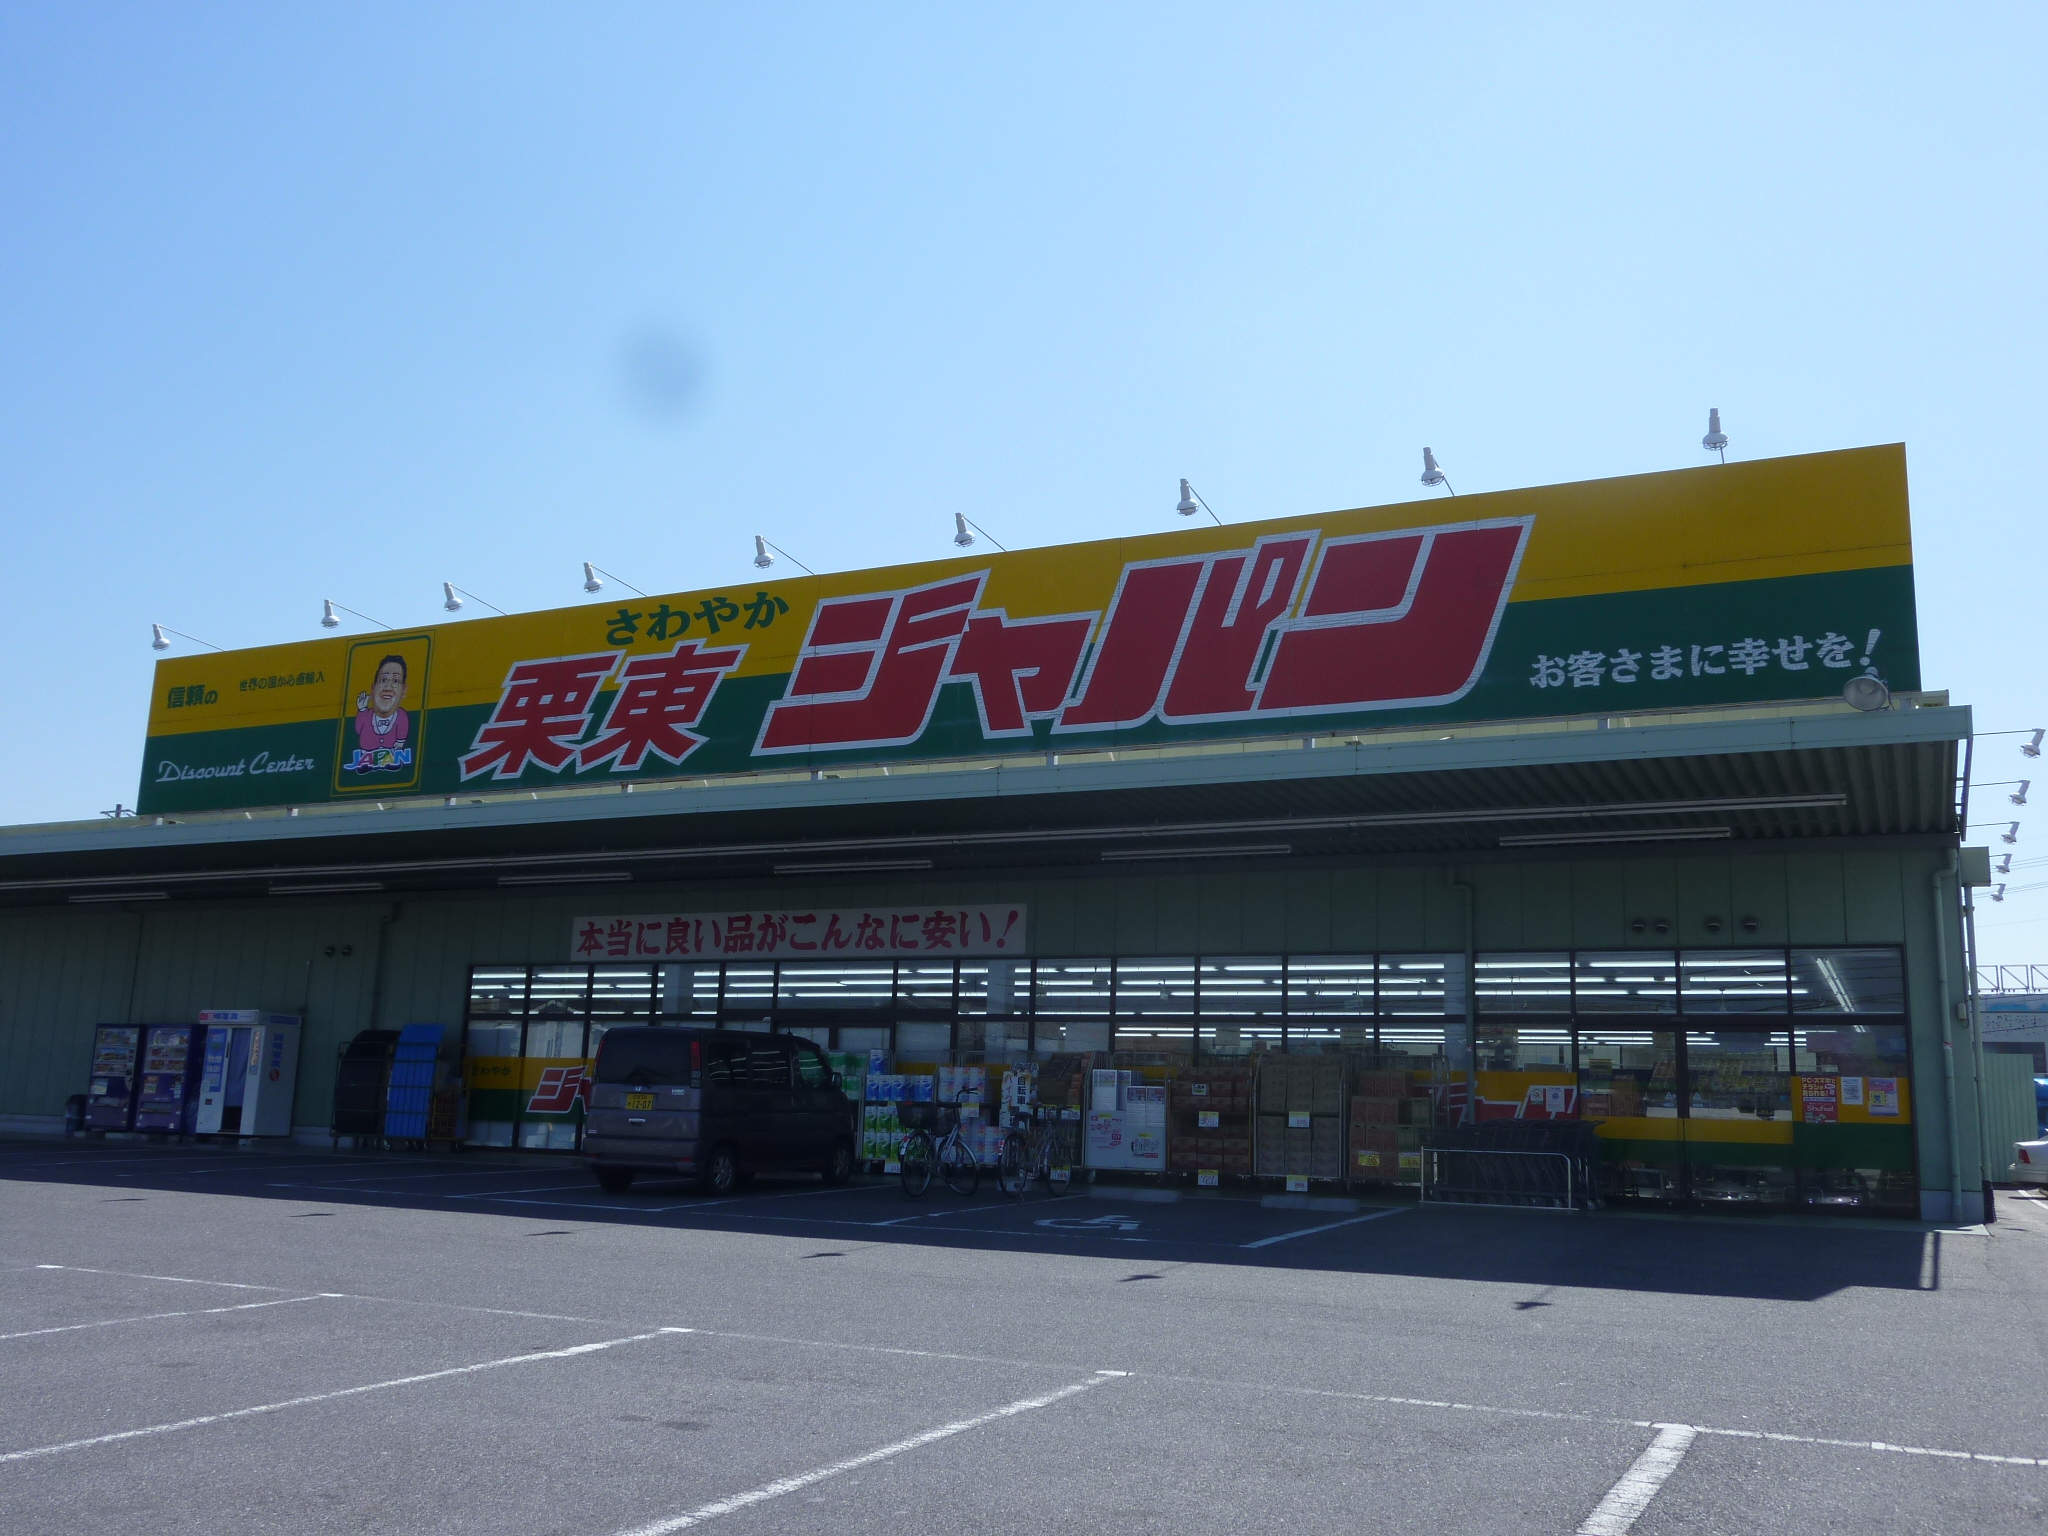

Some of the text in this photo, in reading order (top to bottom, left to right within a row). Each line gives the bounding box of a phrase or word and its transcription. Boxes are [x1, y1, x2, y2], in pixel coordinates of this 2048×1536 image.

[605, 591, 789, 646] さわやか
[458, 514, 1536, 782] 栗東 ジャパン
[167, 684, 218, 708] 信頼の
[239, 671, 325, 692] 世界の国から直輸入
[155, 751, 315, 782] Discount Center
[343, 748, 412, 770] JAPAN
[576, 909, 1020, 956] 本当に良い品がこんなに安い!
[471, 1065, 512, 1076] さわやか
[1017, 1076, 1027, 1105] 自転車
